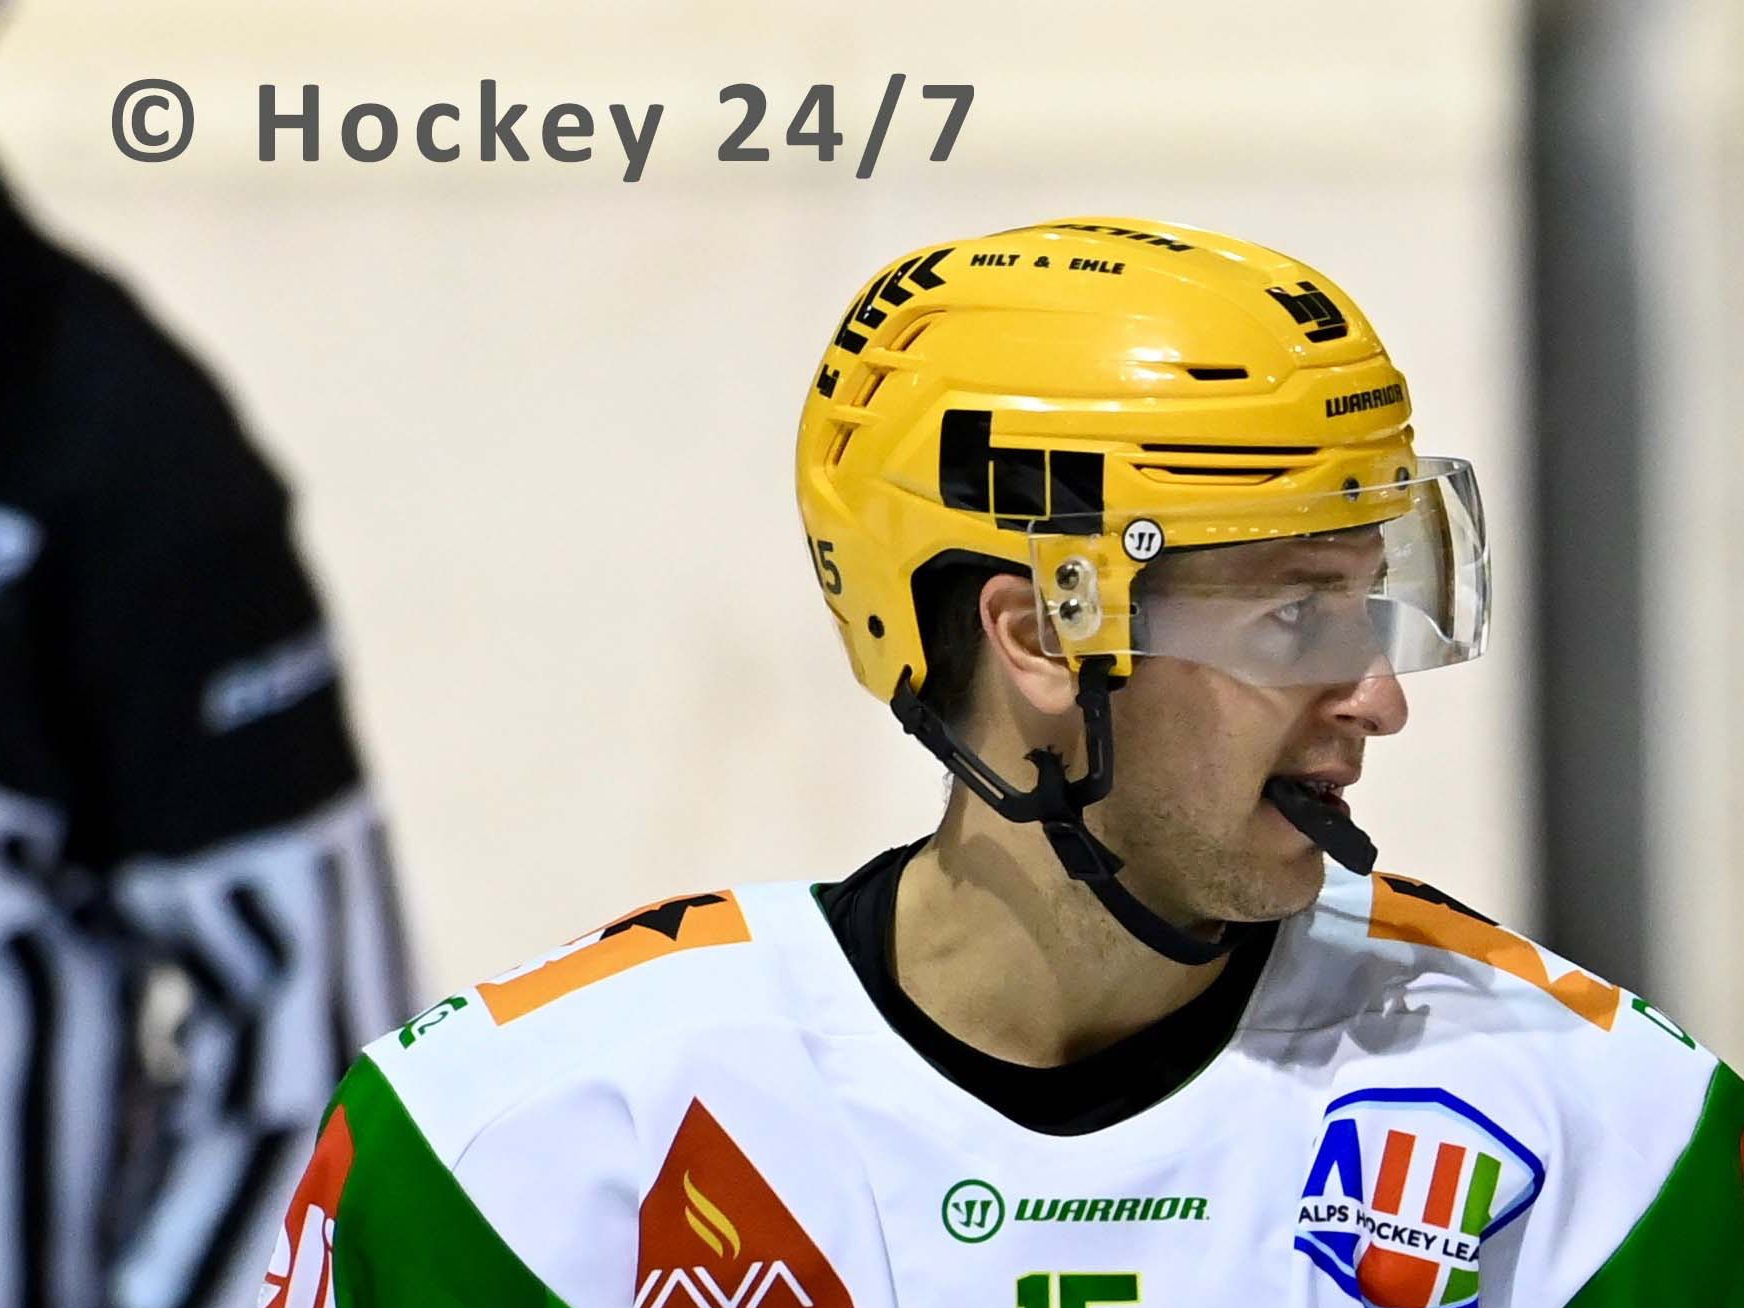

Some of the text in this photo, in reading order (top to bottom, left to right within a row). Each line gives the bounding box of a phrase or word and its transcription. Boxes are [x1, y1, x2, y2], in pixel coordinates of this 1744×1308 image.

[969, 253, 1126, 276] HILT & EHLE
[1298, 1204, 1349, 1226] ALPS
[1355, 1207, 1438, 1252] HOCKEY
